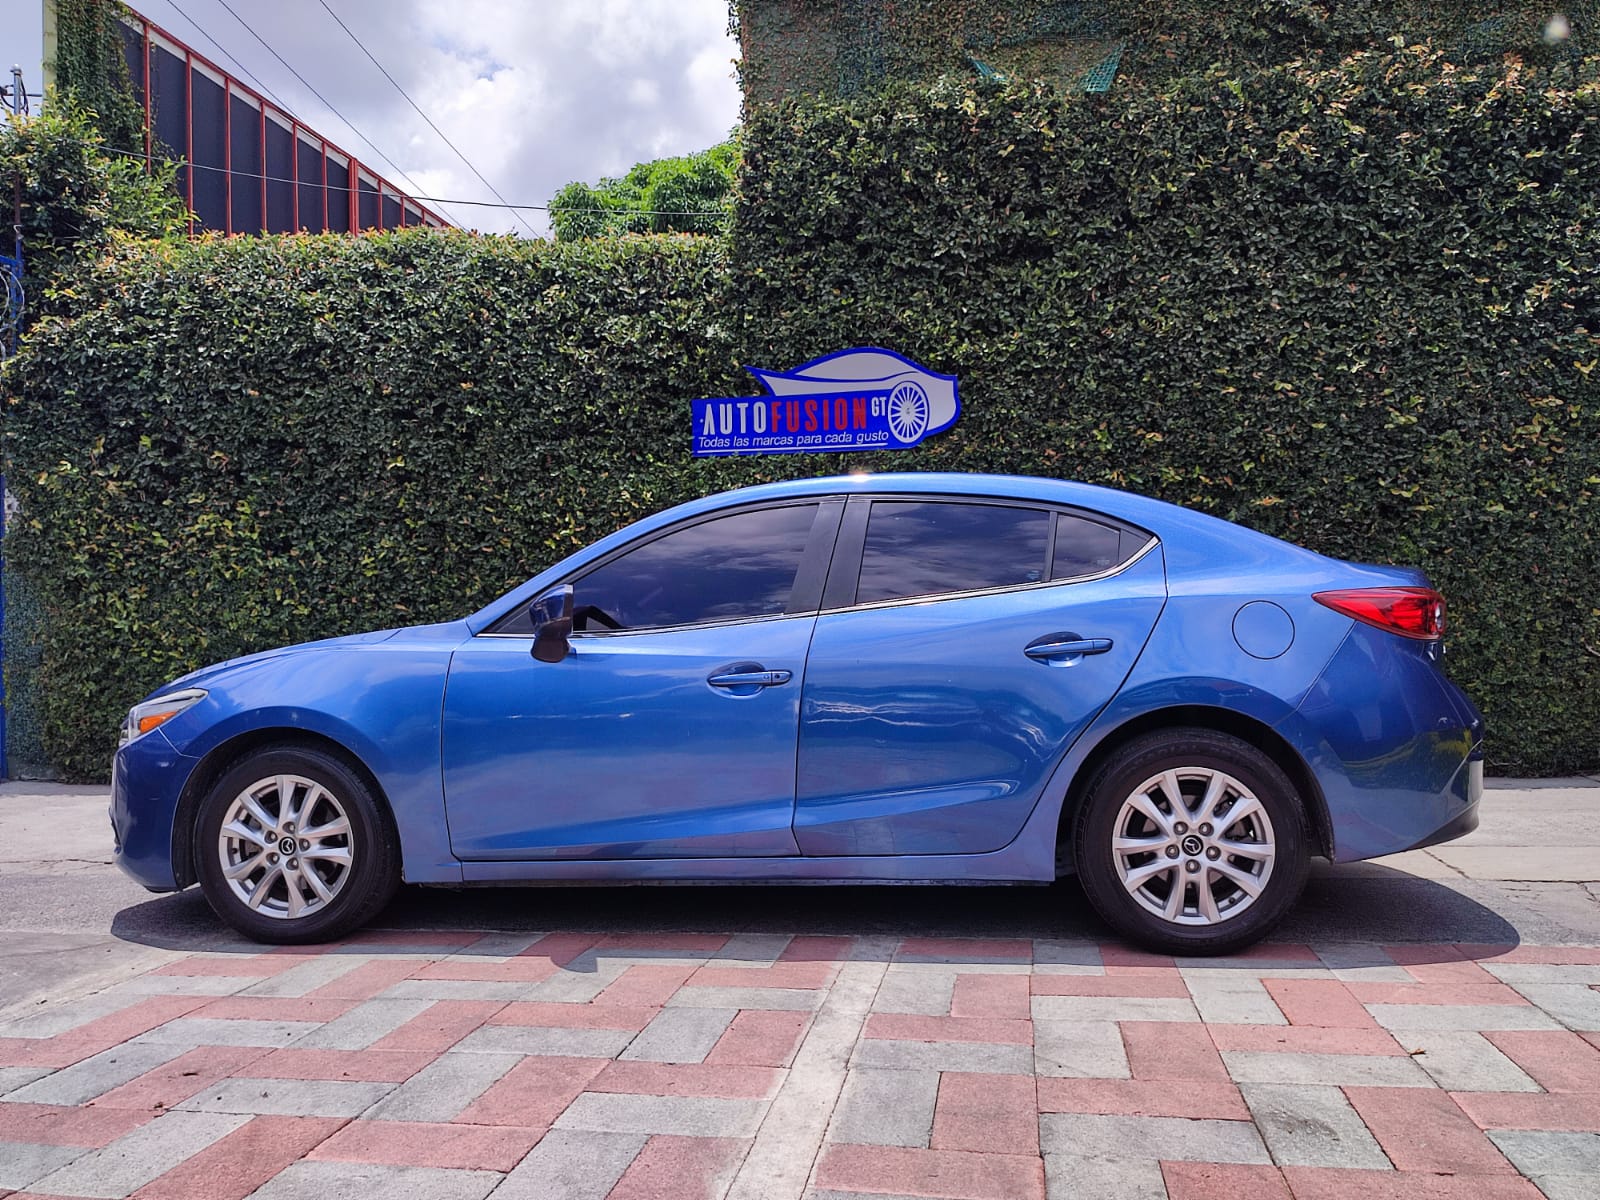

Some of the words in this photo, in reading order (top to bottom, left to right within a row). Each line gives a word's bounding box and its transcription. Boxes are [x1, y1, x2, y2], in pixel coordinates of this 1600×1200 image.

[871, 396, 887, 417] GT
[698, 436, 730, 448] Todas
[733, 436, 749, 447] las
[752, 435, 793, 447] marcas
[796, 434, 822, 447] para
[824, 432, 852, 444] cada
[856, 430, 889, 445] gusto
